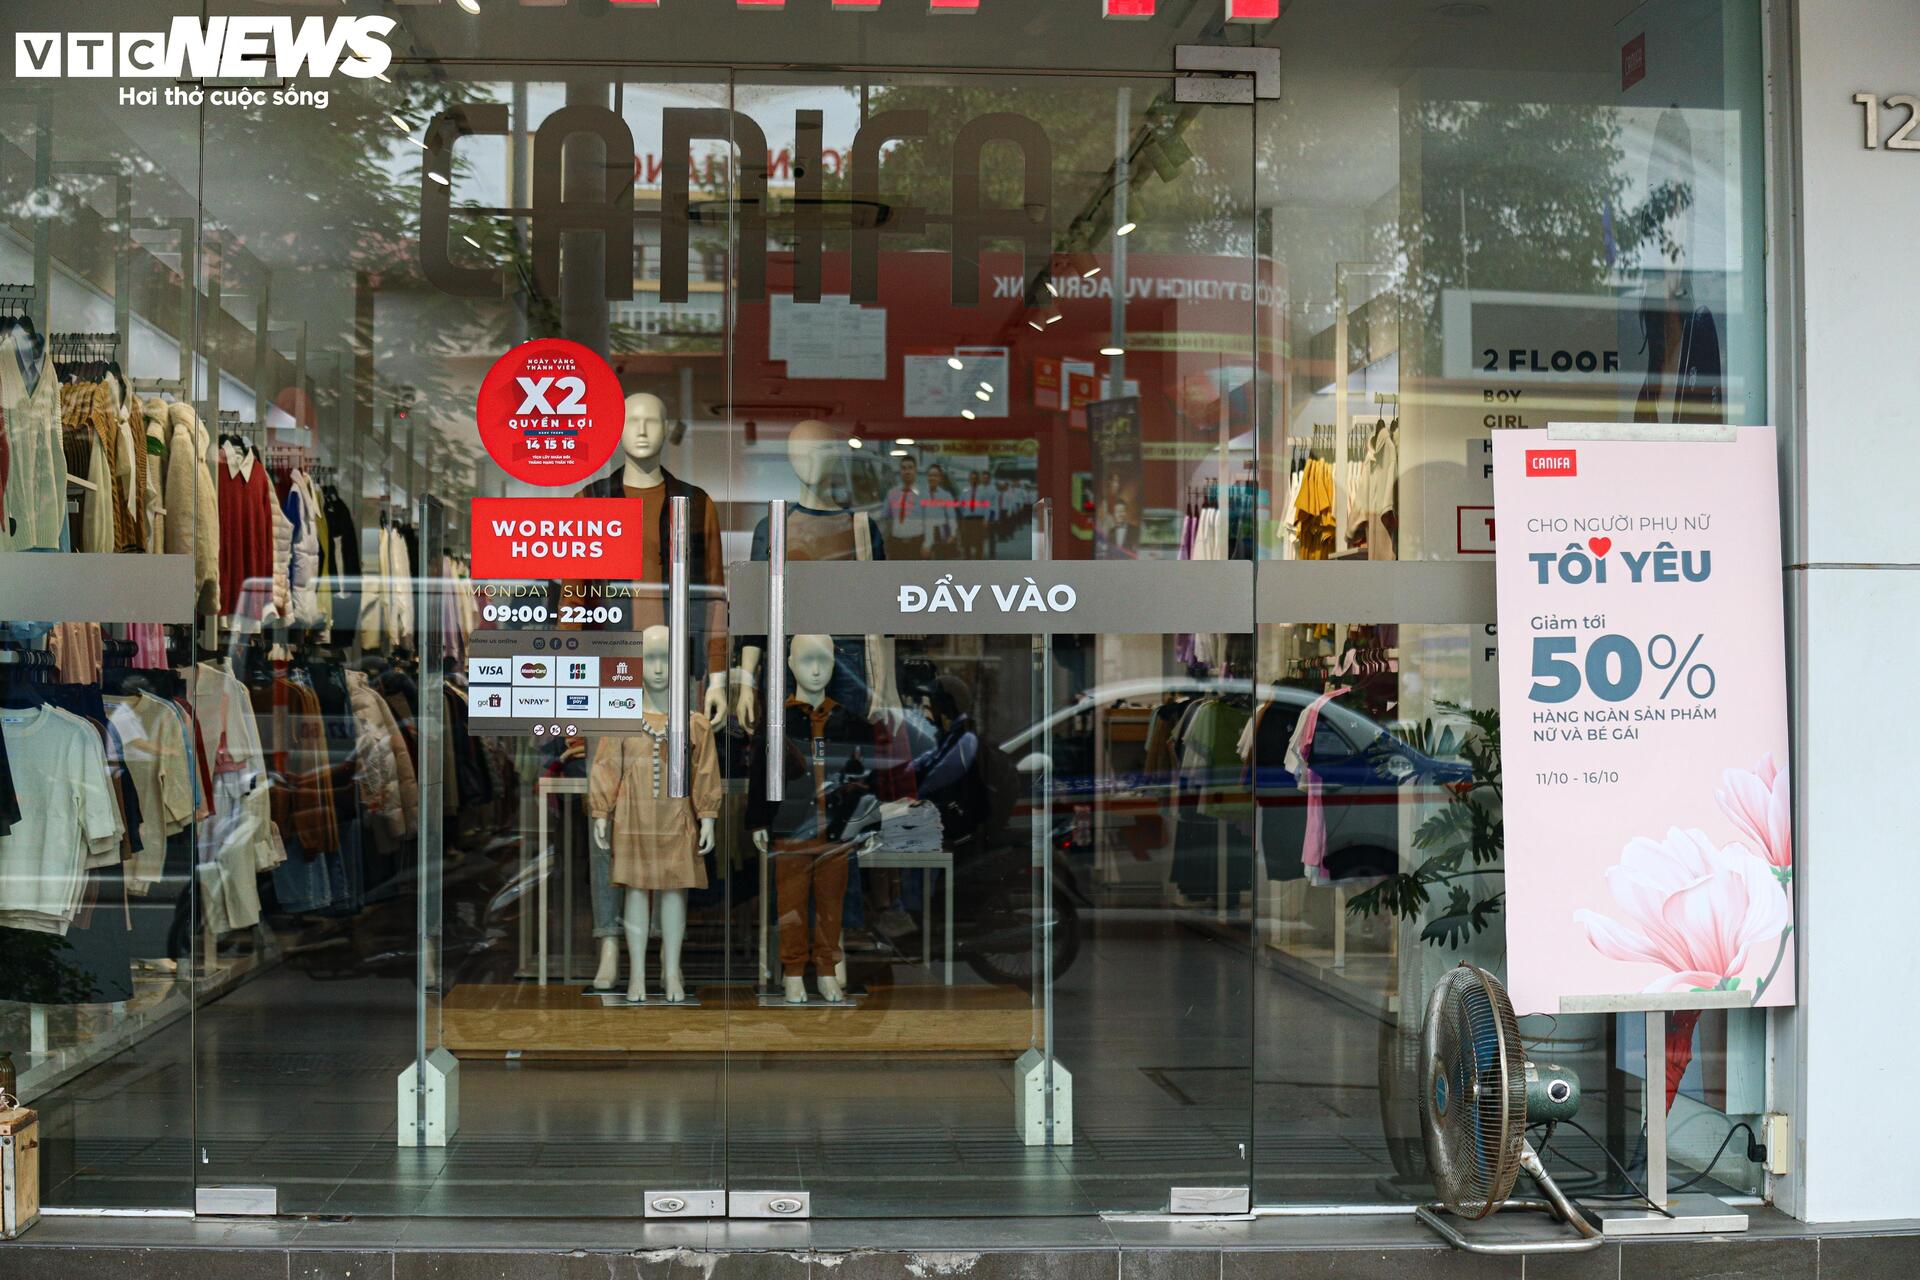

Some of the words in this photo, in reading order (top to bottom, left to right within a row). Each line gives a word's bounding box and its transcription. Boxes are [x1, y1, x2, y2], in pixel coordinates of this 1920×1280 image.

[420, 103, 1053, 306] CANIFA
[1483, 350, 1499, 371] 2
[515, 376, 587, 415] X2
[1483, 390, 1522, 403] BOY
[508, 417, 559, 429] QUYỀN
[568, 418, 593, 429] LỢI
[1483, 415, 1529, 429] GIRL
[526, 440, 541, 449] 14
[544, 440, 557, 449] 15
[561, 440, 575, 449] 16
[1532, 457, 1571, 470] CANIFA
[491, 520, 623, 537] WORKING
[1527, 518, 1568, 533] CHO
[1574, 514, 1634, 532] NGƯỜI
[1640, 516, 1678, 534] PHỤ
[1685, 514, 1712, 531] NỮ
[511, 541, 604, 558] HOURS
[1620, 541, 1712, 583] YÊU
[467, 584, 549, 598] MONDAY
[563, 584, 641, 598] SUNDAY
[897, 573, 982, 612] ĐẨY
[990, 577, 1077, 612] VÀO
[1530, 615, 1578, 631] Giảm
[1583, 615, 1606, 630] tới
[479, 666, 504, 675] VISA
[1528, 632, 1717, 704] 50%
[477, 699, 489, 708] got
[1533, 707, 1579, 723] HÀNG
[1584, 706, 1630, 722] NGÀN
[1634, 705, 1666, 721] SẢN
[1671, 703, 1717, 720] PHẨM
[1533, 727, 1557, 742] NỮ
[1561, 726, 1583, 741] VÀ
[1587, 725, 1608, 740] BÉ
[1613, 725, 1639, 740] GÁI
[1536, 773, 1569, 785] 11/10
[1583, 771, 1619, 784] 16/10
